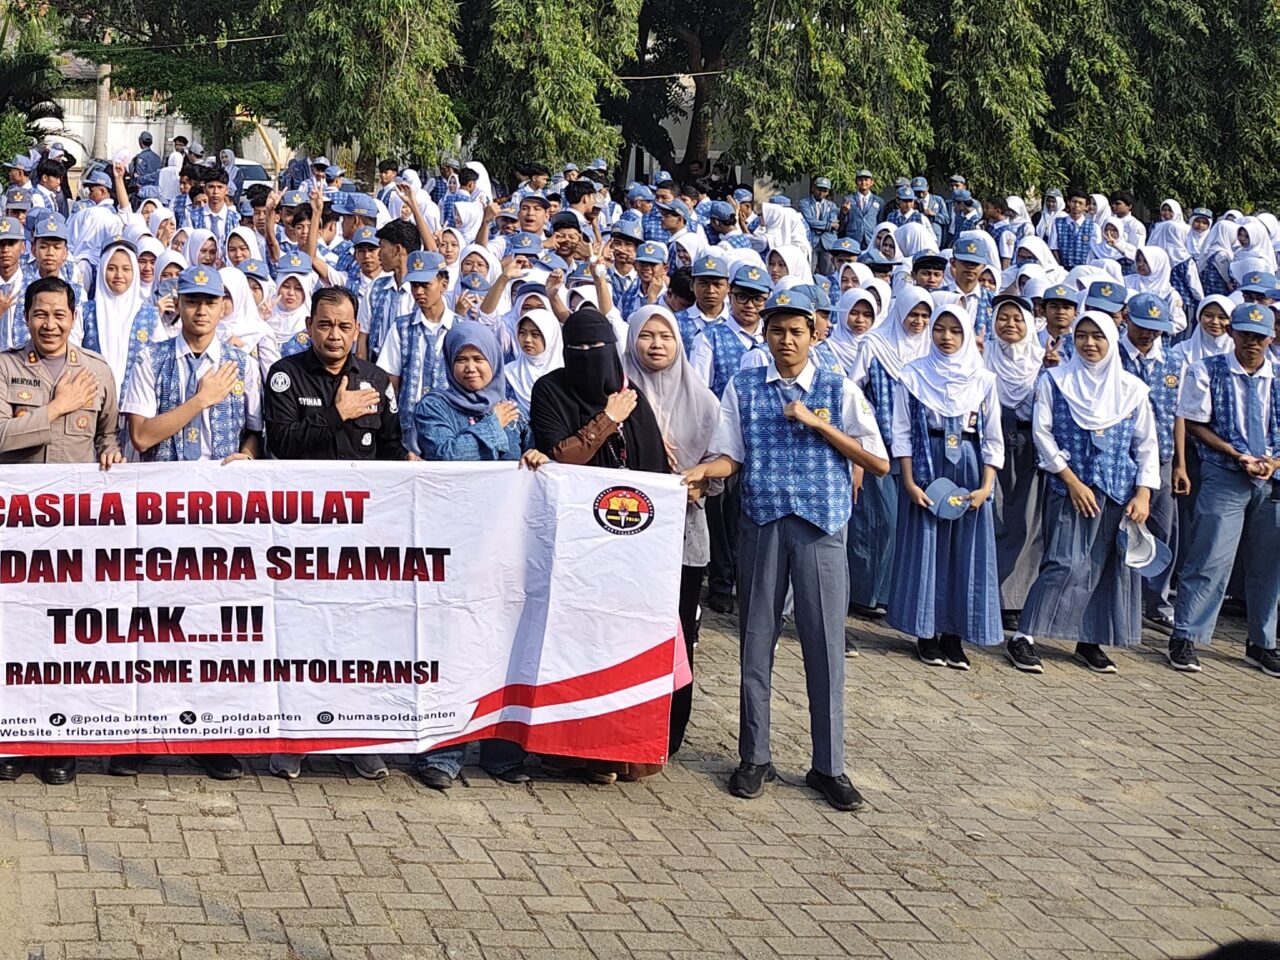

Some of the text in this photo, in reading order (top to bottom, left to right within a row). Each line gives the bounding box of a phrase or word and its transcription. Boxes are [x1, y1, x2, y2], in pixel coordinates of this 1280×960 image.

[136, 490, 371, 525] BERDAULAT
[0, 548, 83, 584] DAN
[94, 546, 258, 582] NEGARA
[265, 545, 452, 582] SELAMAT
[46, 605, 264, 645] TOLAK...!!!
[5, 659, 193, 685] RADIKALISME
[199, 658, 256, 684] DAN
[262, 657, 440, 684] INTOLERANSI
[0, 727, 52, 738] Website
[65, 723, 271, 738] tribratanews.banten.polri.go.id
[70, 713, 168, 727] @polda banten
[200, 712, 302, 724] @_poldabanten
